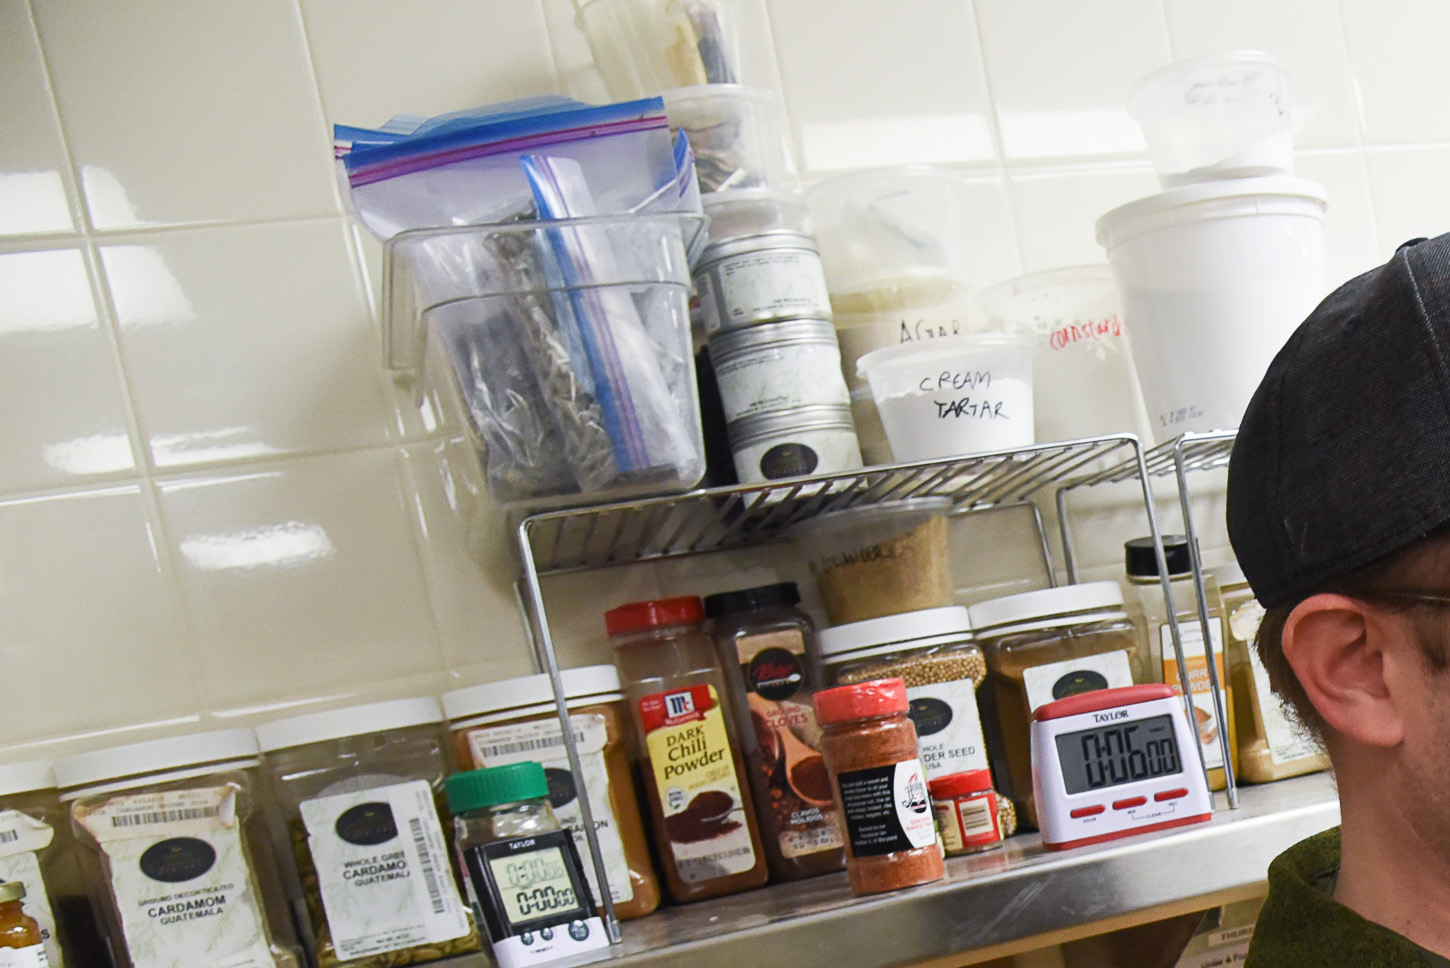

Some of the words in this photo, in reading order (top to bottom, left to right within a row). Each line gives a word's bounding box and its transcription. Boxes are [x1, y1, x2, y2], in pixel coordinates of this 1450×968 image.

[919, 371, 991, 391] CREAM
[933, 397, 1010, 419] TARTAR
[1092, 710, 1129, 723] TAYLOR
[666, 725, 705, 747] DARK
[668, 736, 707, 761] Chili
[948, 746, 976, 759] SEED
[664, 748, 725, 780] Powder
[509, 838, 536, 849] TAYLOR
[147, 895, 227, 918] CARDAMOM
[160, 907, 225, 925] GUATEMALA
